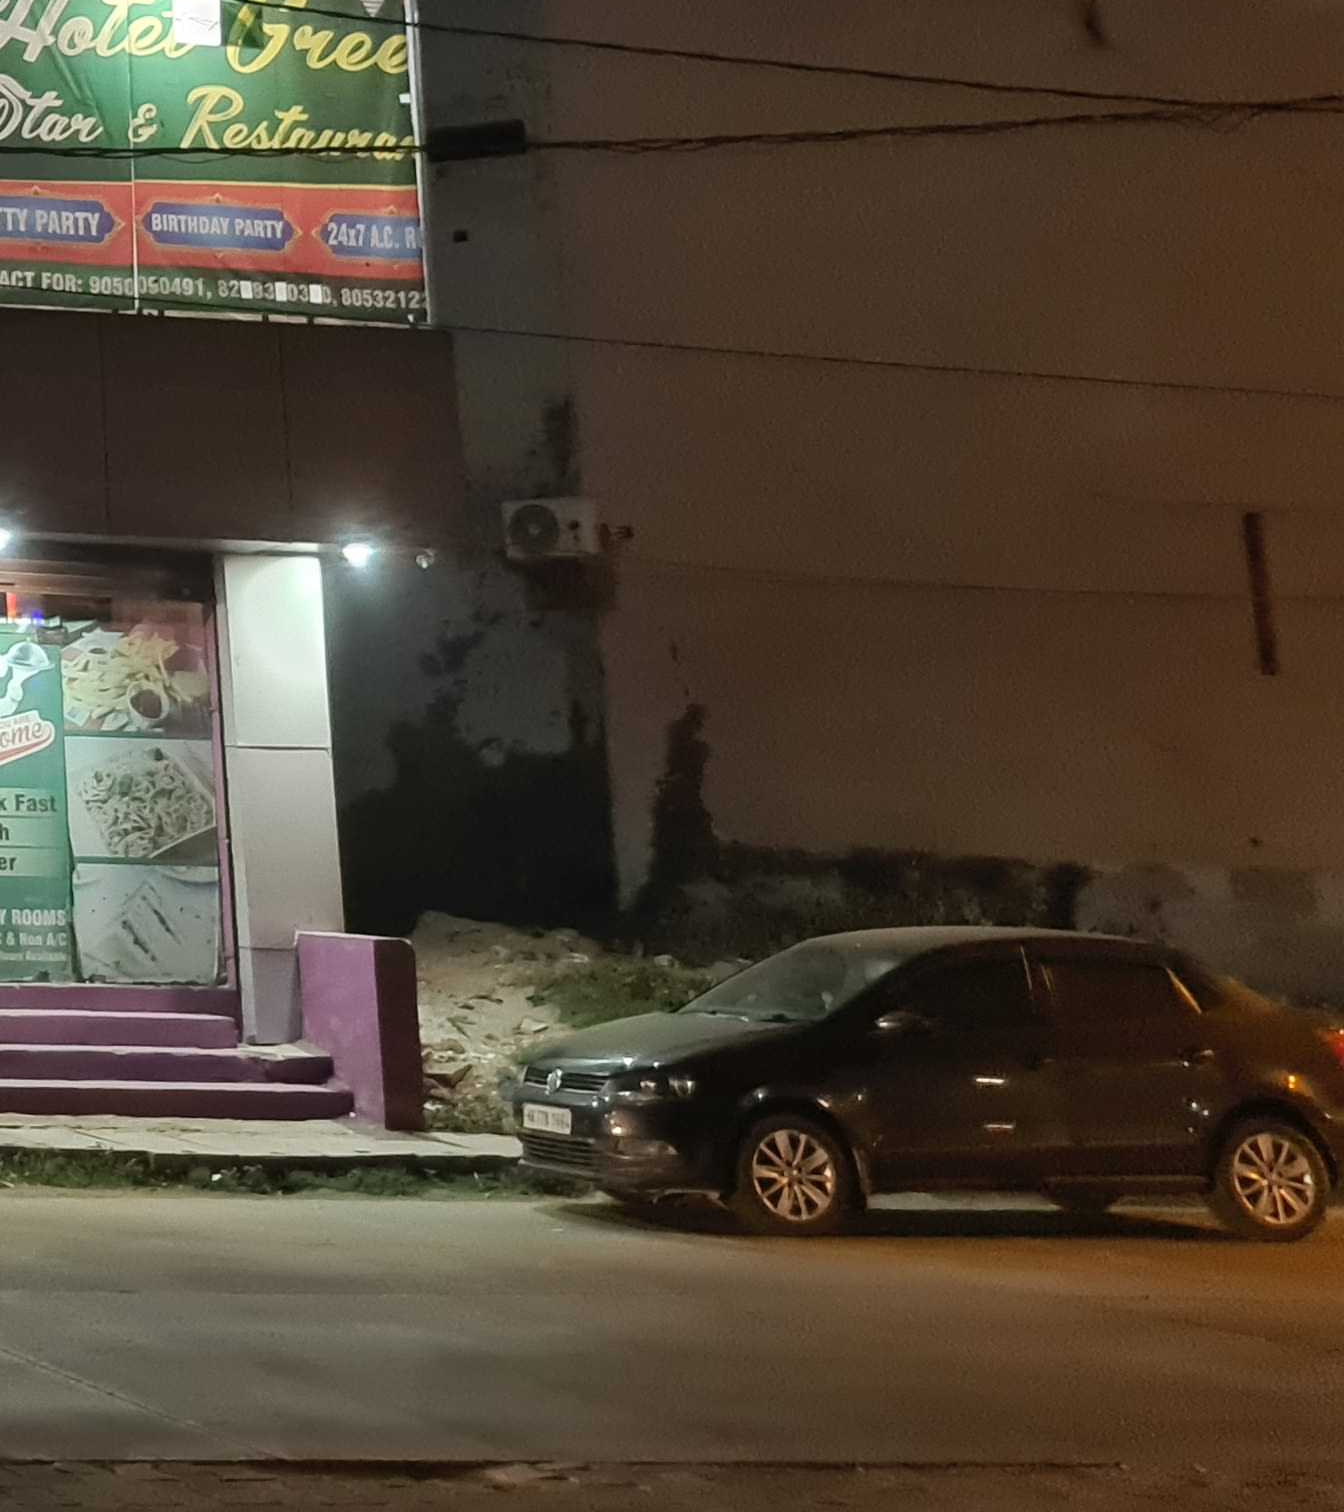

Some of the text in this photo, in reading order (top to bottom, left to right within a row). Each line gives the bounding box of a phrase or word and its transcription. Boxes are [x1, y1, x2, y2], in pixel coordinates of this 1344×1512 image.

[129, 102, 159, 145] &
[35, 209, 101, 236] PARTY
[151, 213, 284, 239] BIRTHDAY PARTY
[327, 222, 400, 250] 24x7 A.C.
[41, 272, 83, 292] FOR:
[15, 794, 57, 813] Fast
[12, 908, 67, 927] ROOMS
